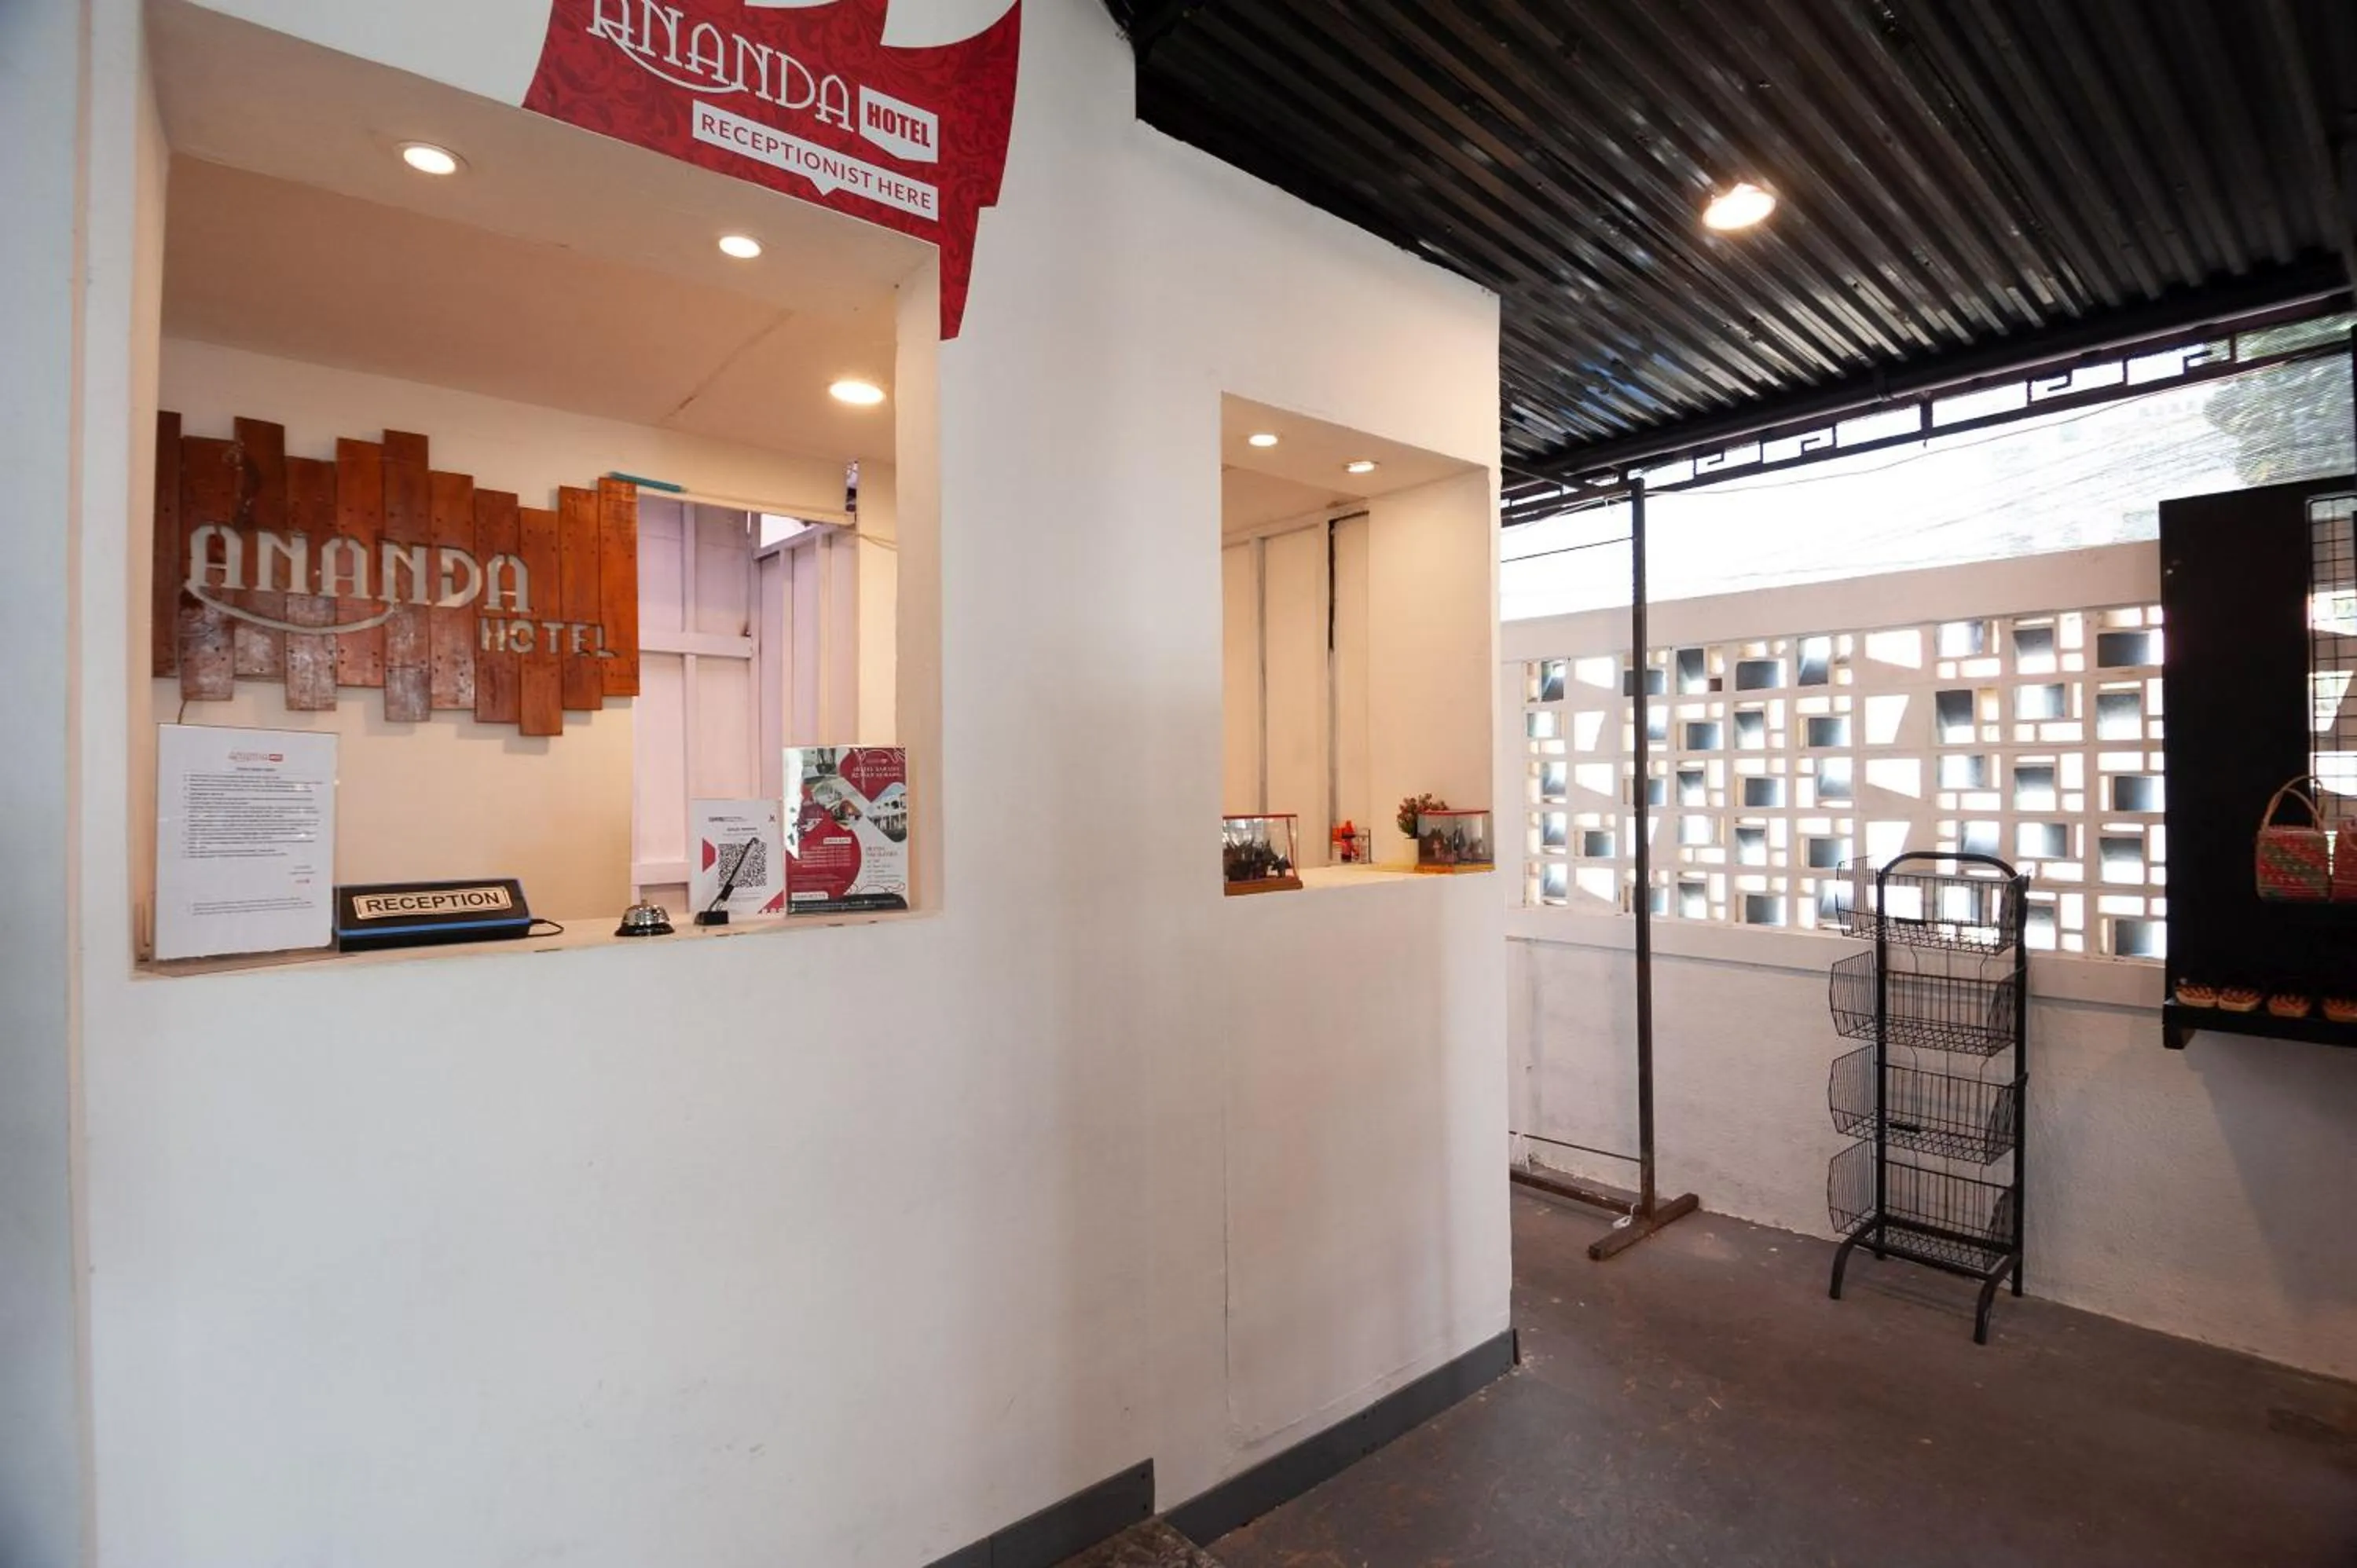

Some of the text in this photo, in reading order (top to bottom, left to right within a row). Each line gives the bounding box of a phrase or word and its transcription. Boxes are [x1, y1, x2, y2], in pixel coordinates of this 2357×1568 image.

[586, 0, 930, 148] ANANDA HOTEL
[702, 113, 931, 210] RECEPTIONIST HERE
[185, 523, 533, 633] ANANDA
[480, 617, 617, 658] HOTEL
[365, 892, 500, 912] RECEPTION
